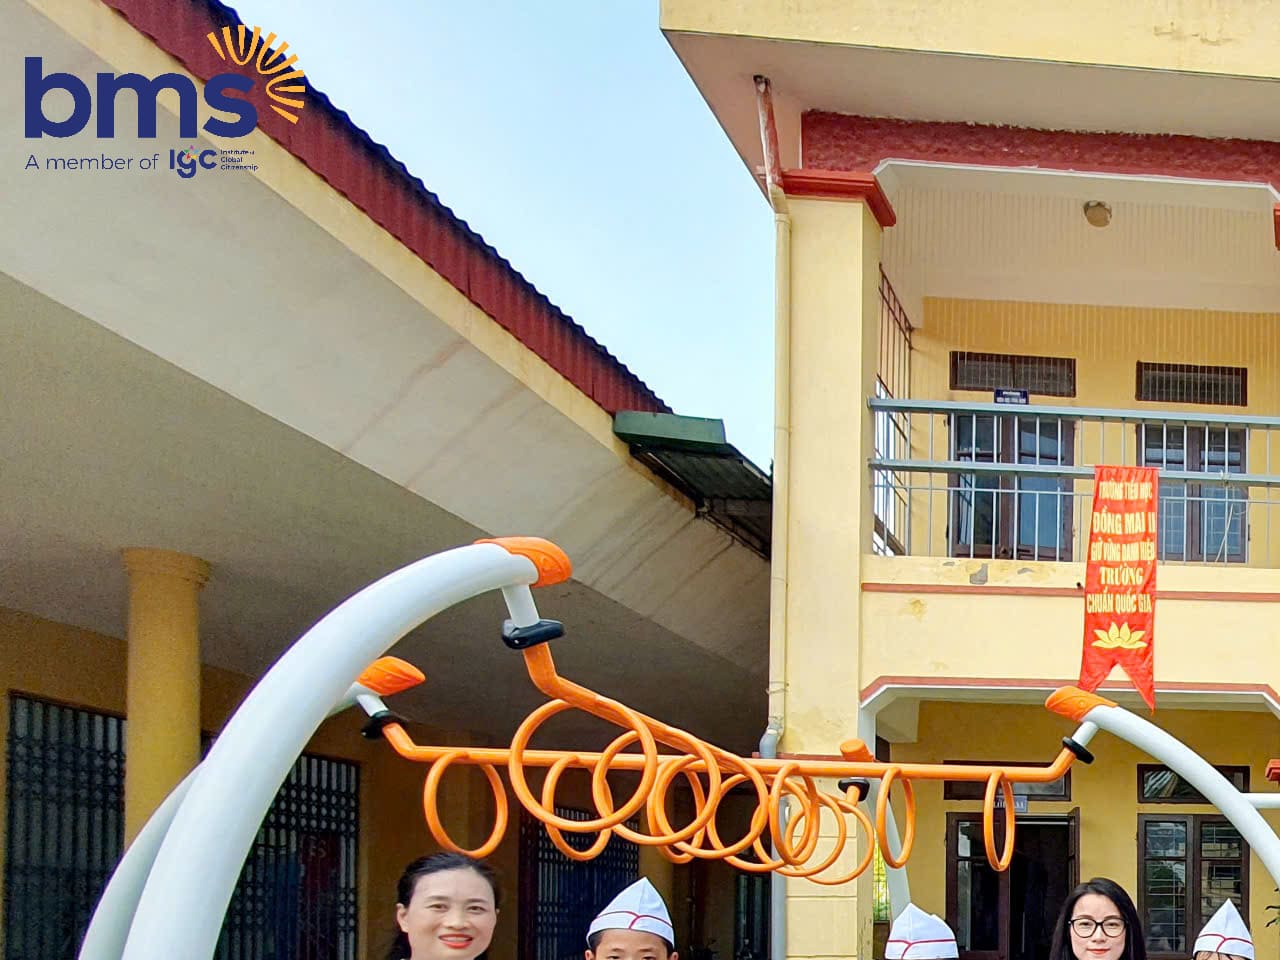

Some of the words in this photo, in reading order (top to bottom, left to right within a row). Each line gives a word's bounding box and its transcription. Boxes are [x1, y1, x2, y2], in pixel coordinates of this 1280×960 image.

[1124, 511, 1145, 534] MAI
[1100, 563, 1144, 586] TRƯỜNG
[1138, 593, 1152, 613] GIA
